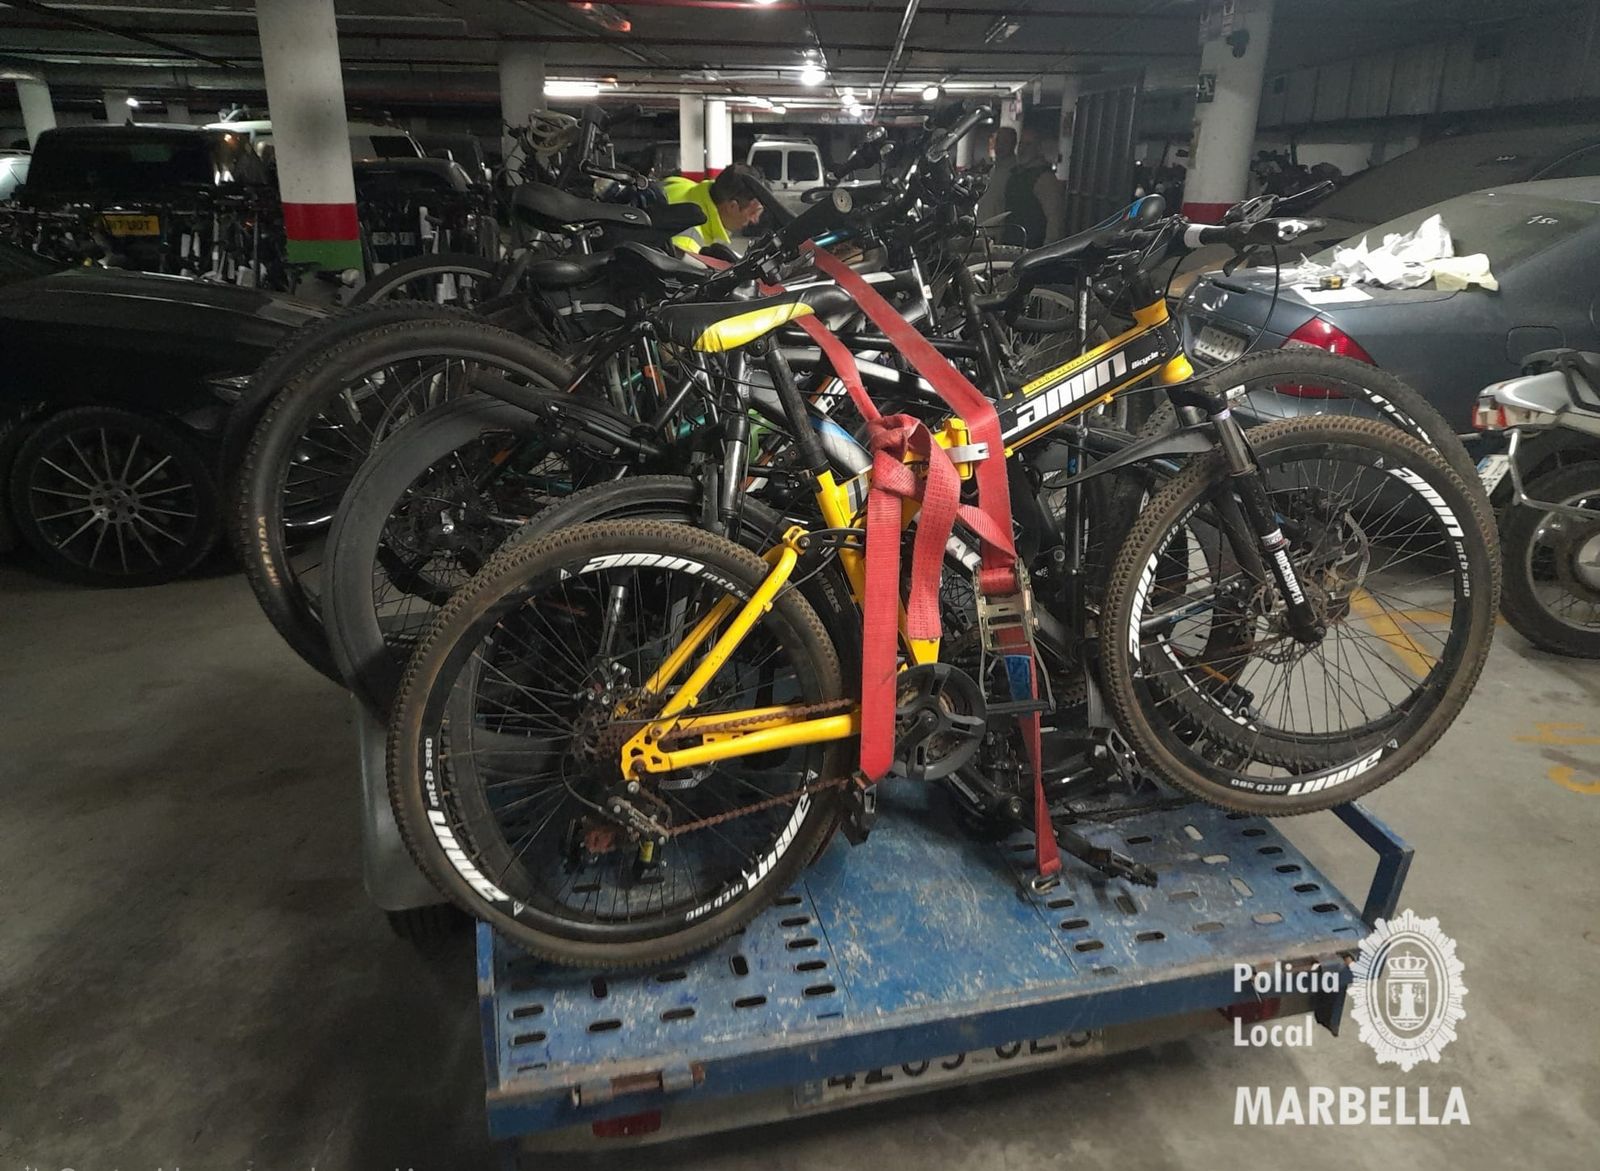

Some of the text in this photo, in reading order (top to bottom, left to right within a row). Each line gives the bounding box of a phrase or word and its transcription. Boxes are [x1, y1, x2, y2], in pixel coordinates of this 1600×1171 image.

[1131, 351, 1160, 370] Bicycle
[1180, 502, 1200, 525] 580
[1454, 541, 1469, 571] mtb
[702, 571, 736, 590] mtb
[1274, 549, 1305, 605] ROCKSUPER
[1461, 571, 1470, 598] 580
